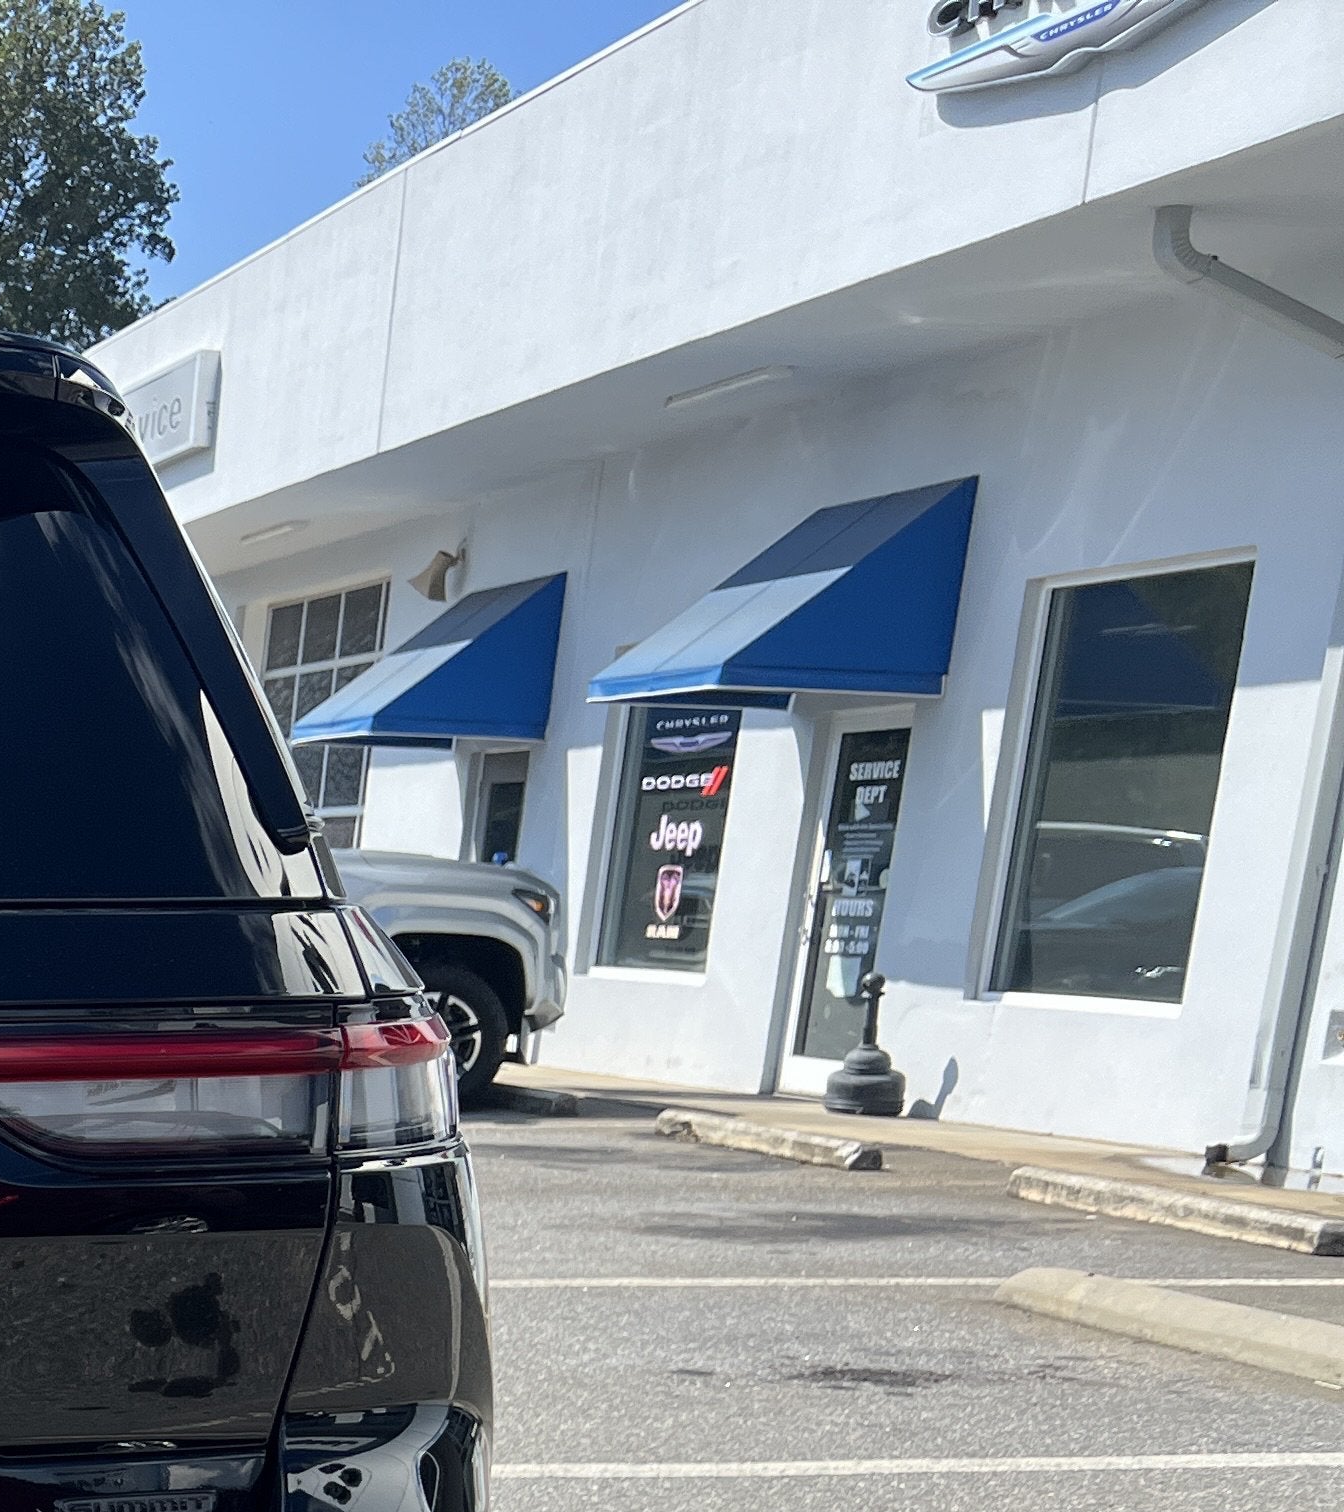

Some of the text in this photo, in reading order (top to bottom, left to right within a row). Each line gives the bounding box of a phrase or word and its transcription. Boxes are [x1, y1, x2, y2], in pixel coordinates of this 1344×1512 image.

[1039, 3, 1113, 40] CHRYSLER
[138, 396, 182, 441] vice
[849, 760, 901, 781] SERVICE
[641, 771, 717, 792] DODGE
[855, 785, 888, 805] DEPT
[650, 814, 702, 857] Jeep
[832, 899, 873, 917] HOURS
